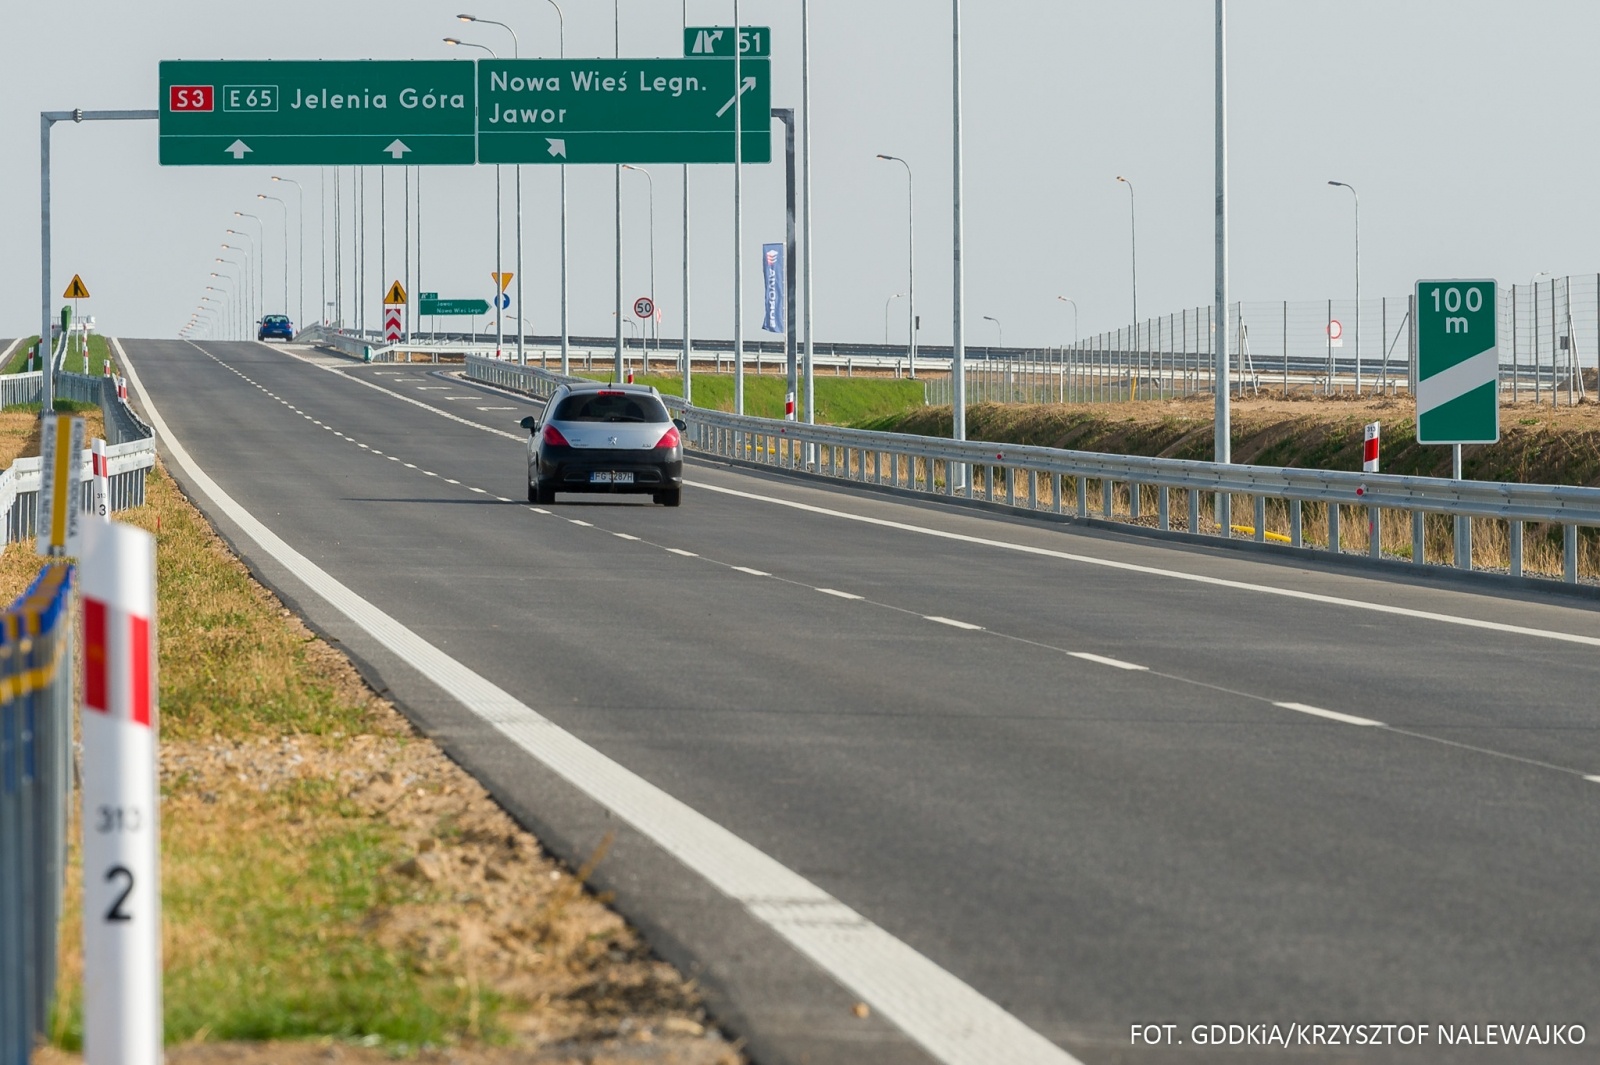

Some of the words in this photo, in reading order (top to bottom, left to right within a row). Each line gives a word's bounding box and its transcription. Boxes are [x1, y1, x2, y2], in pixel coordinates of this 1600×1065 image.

[739, 32, 760, 53] 51
[490, 71, 560, 92] Nowa
[570, 71, 628, 92] Wieś
[640, 71, 707, 97] Legn.
[176, 89, 205, 108] S3
[230, 89, 241, 107] E
[246, 89, 272, 107] 65
[290, 88, 388, 109] Jelenia
[399, 87, 465, 109] Góra
[488, 103, 567, 124] Jawor
[637, 302, 651, 314] 50
[1430, 287, 1483, 313] 100
[1445, 316, 1469, 334] m
[98, 503, 107, 517] 3
[104, 864, 134, 923] 2
